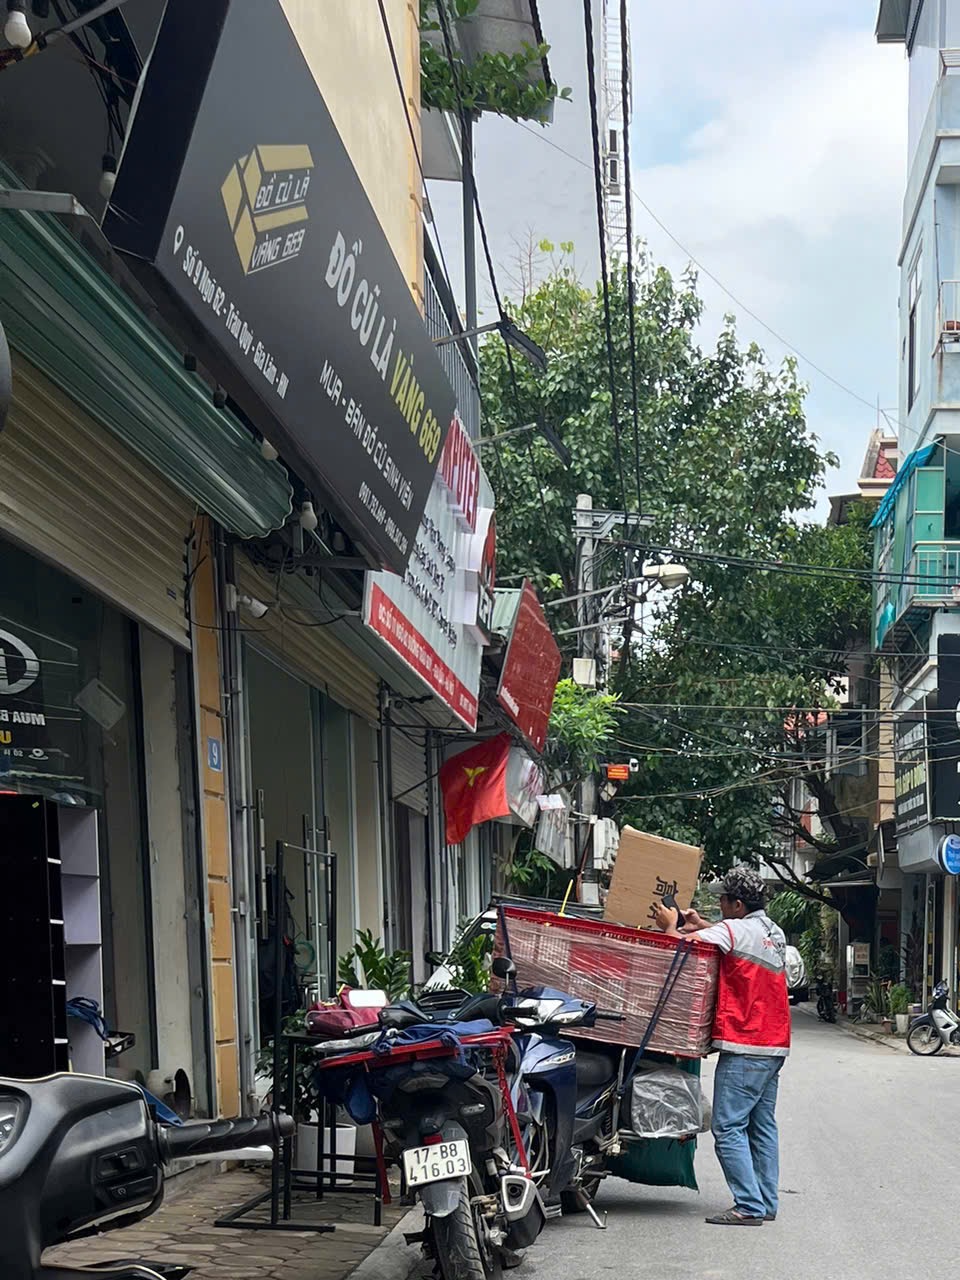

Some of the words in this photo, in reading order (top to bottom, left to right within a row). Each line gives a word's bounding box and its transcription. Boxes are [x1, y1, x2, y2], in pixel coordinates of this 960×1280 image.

[294, 169, 310, 200] LÀ
[252, 233, 282, 268] VÀNG
[282, 228, 305, 258] 669
[182, 245, 199, 277] Số
[193, 260, 202, 286] 9
[212, 286, 225, 316] 62
[324, 230, 362, 307] ĐỒ
[350, 279, 381, 346] CŨ
[370, 316, 396, 381] LÀ
[390, 348, 424, 436] VÀNG
[418, 409, 442, 464] 669
[320, 360, 343, 406] MUA
[344, 398, 366, 440] BÁN
[383, 457, 401, 492] SINH
[211, 742, 218, 764] 9
[410, 1158, 466, 1182] 416.03
[414, 1143, 458, 1164] 17-B8
